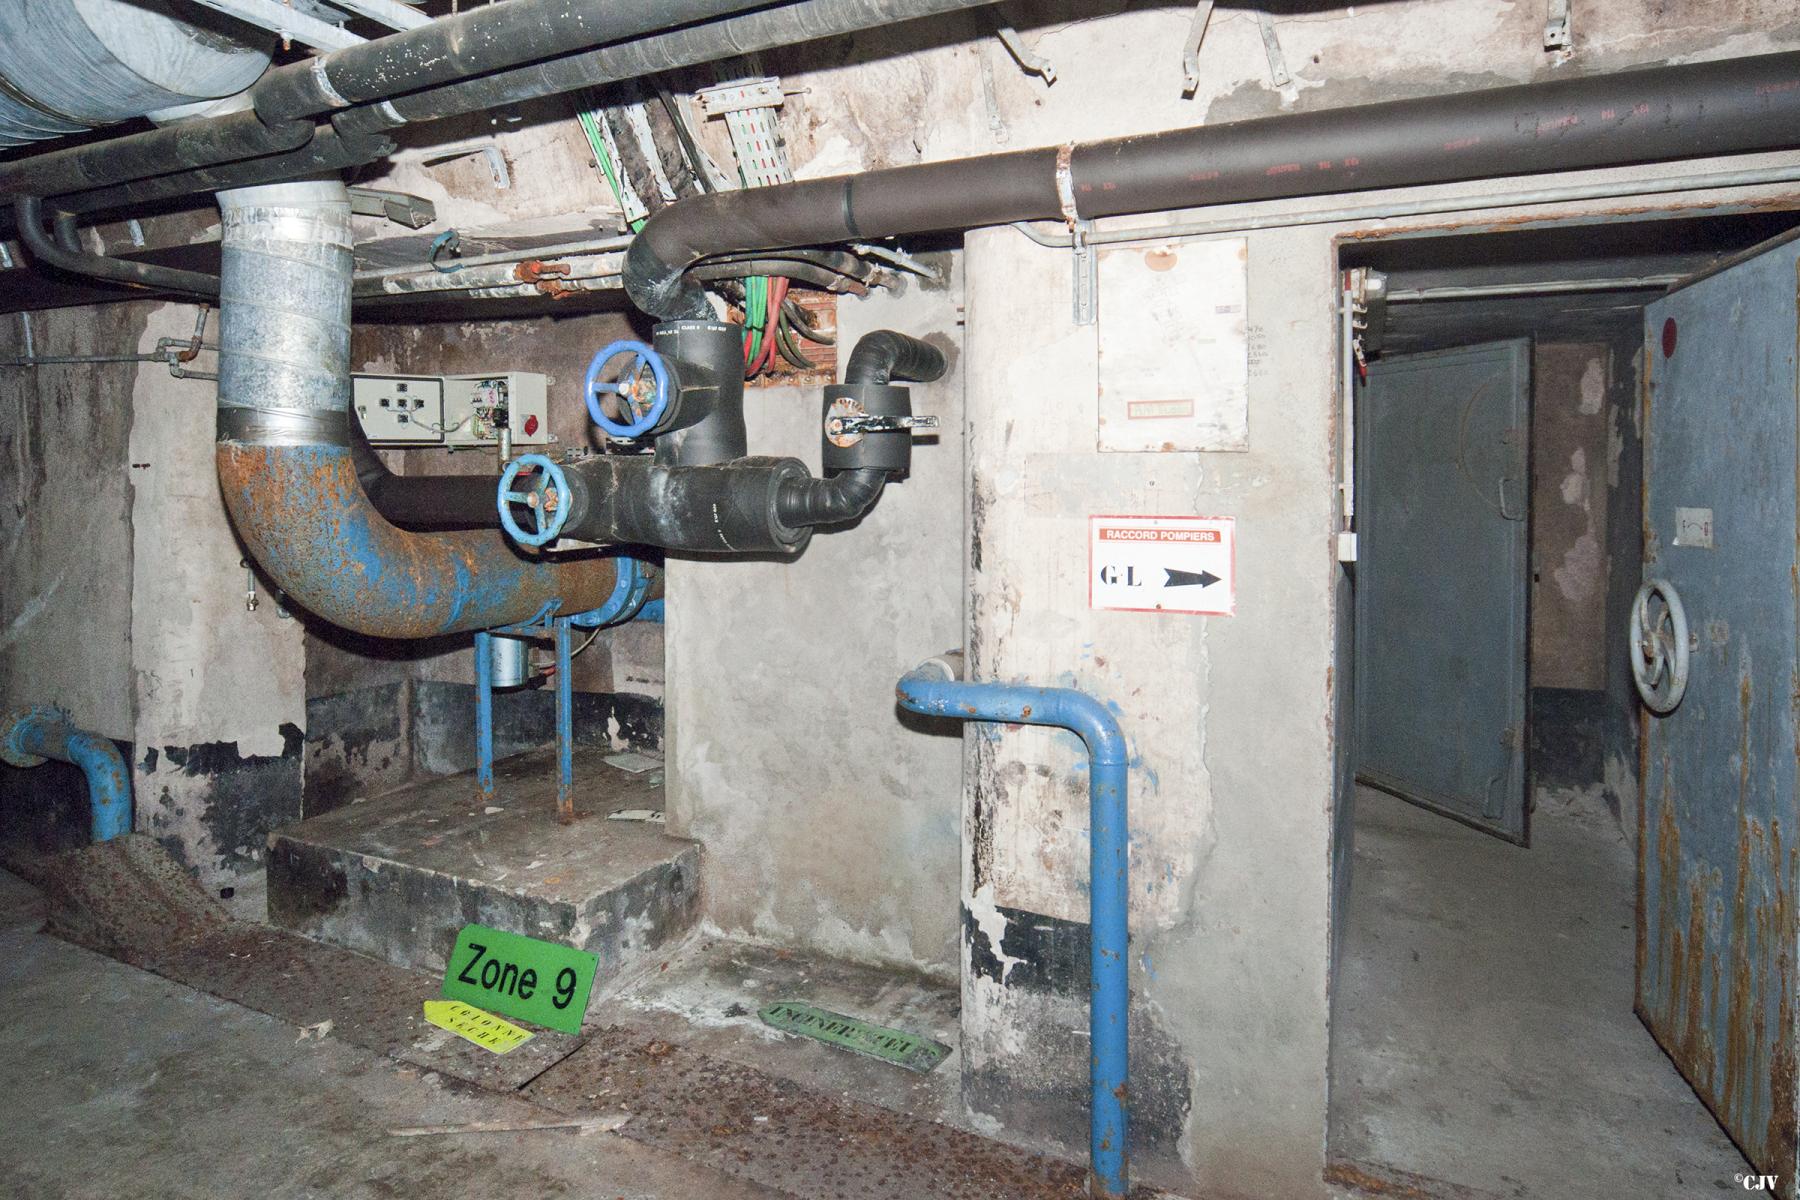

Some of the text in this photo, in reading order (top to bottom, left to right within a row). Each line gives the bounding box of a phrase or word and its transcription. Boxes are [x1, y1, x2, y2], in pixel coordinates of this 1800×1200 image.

[1106, 529, 1215, 542] RACCORD POMPIERS
[458, 943, 577, 1010] Zone 9
